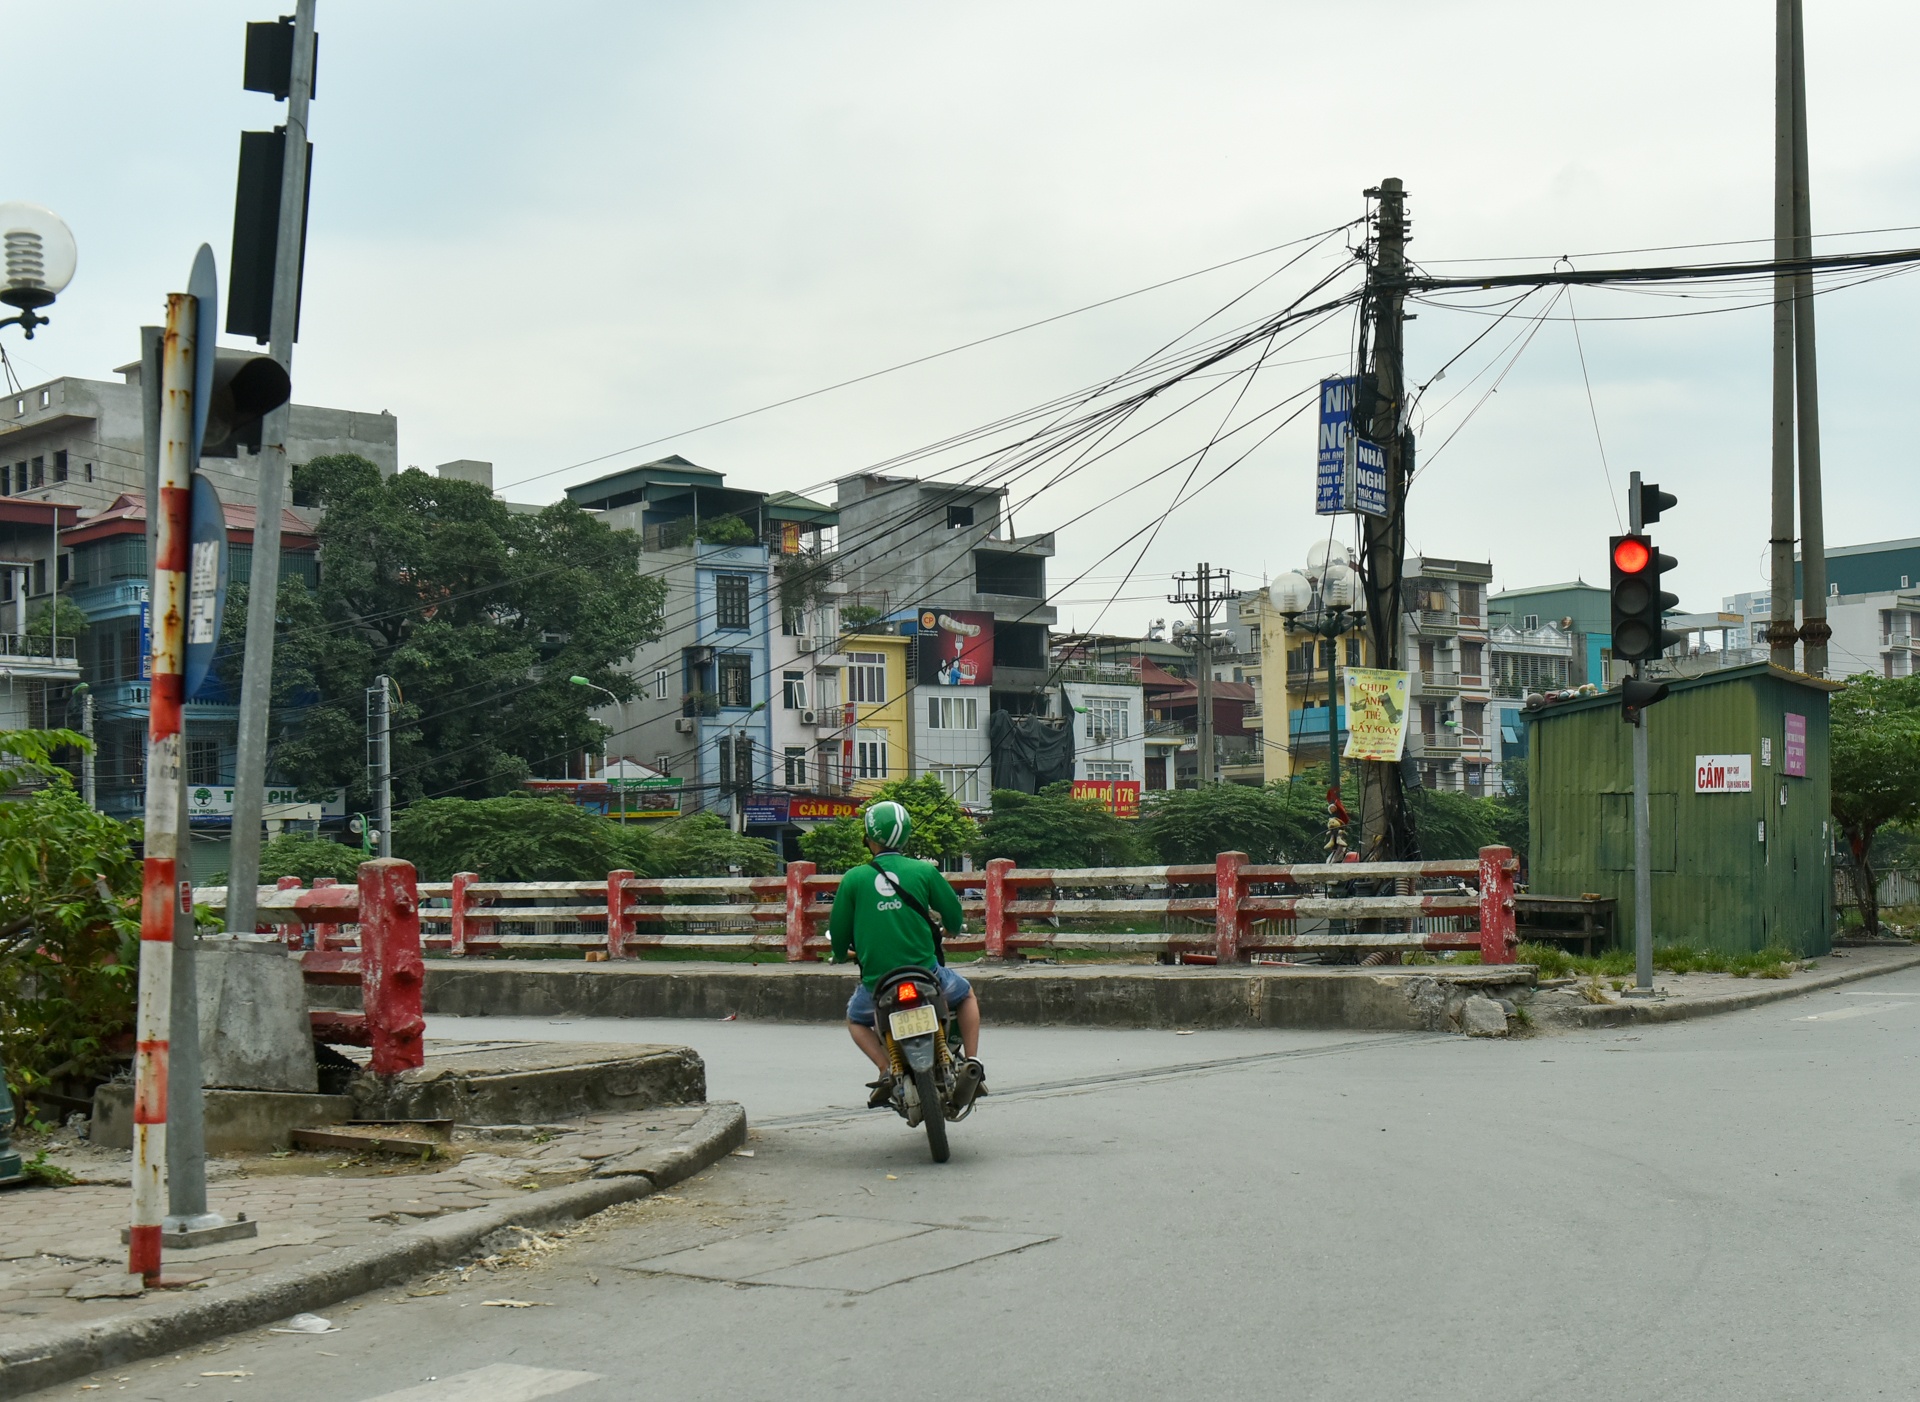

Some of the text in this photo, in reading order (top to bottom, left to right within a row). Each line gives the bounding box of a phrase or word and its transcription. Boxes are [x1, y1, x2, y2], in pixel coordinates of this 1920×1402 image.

[1325, 385, 1356, 413] NH
[1320, 422, 1351, 450] NG
[1319, 452, 1331, 461] LAN
[1359, 446, 1384, 469] NHÀ
[1318, 473, 1344, 486] QUA ĐÊ
[1357, 468, 1387, 491] NGHỈ
[1358, 487, 1372, 499] TRÚC
[1373, 492, 1386, 503] ANH
[923, 616, 934, 624] CP
[1360, 684, 1389, 694] CHỤP
[1365, 692, 1384, 706] ẢNH
[1364, 709, 1381, 720] THẺ
[1351, 721, 1373, 733] LẤY
[1698, 759, 1725, 789] CẤM
[268, 790, 338, 803] PHOG
[1116, 788, 1134, 802] 176
[799, 799, 829, 816] CẦM
[877, 899, 903, 912] Grab
[896, 1010, 929, 1025] 30-L5
[898, 1020, 931, 1036] 9862
